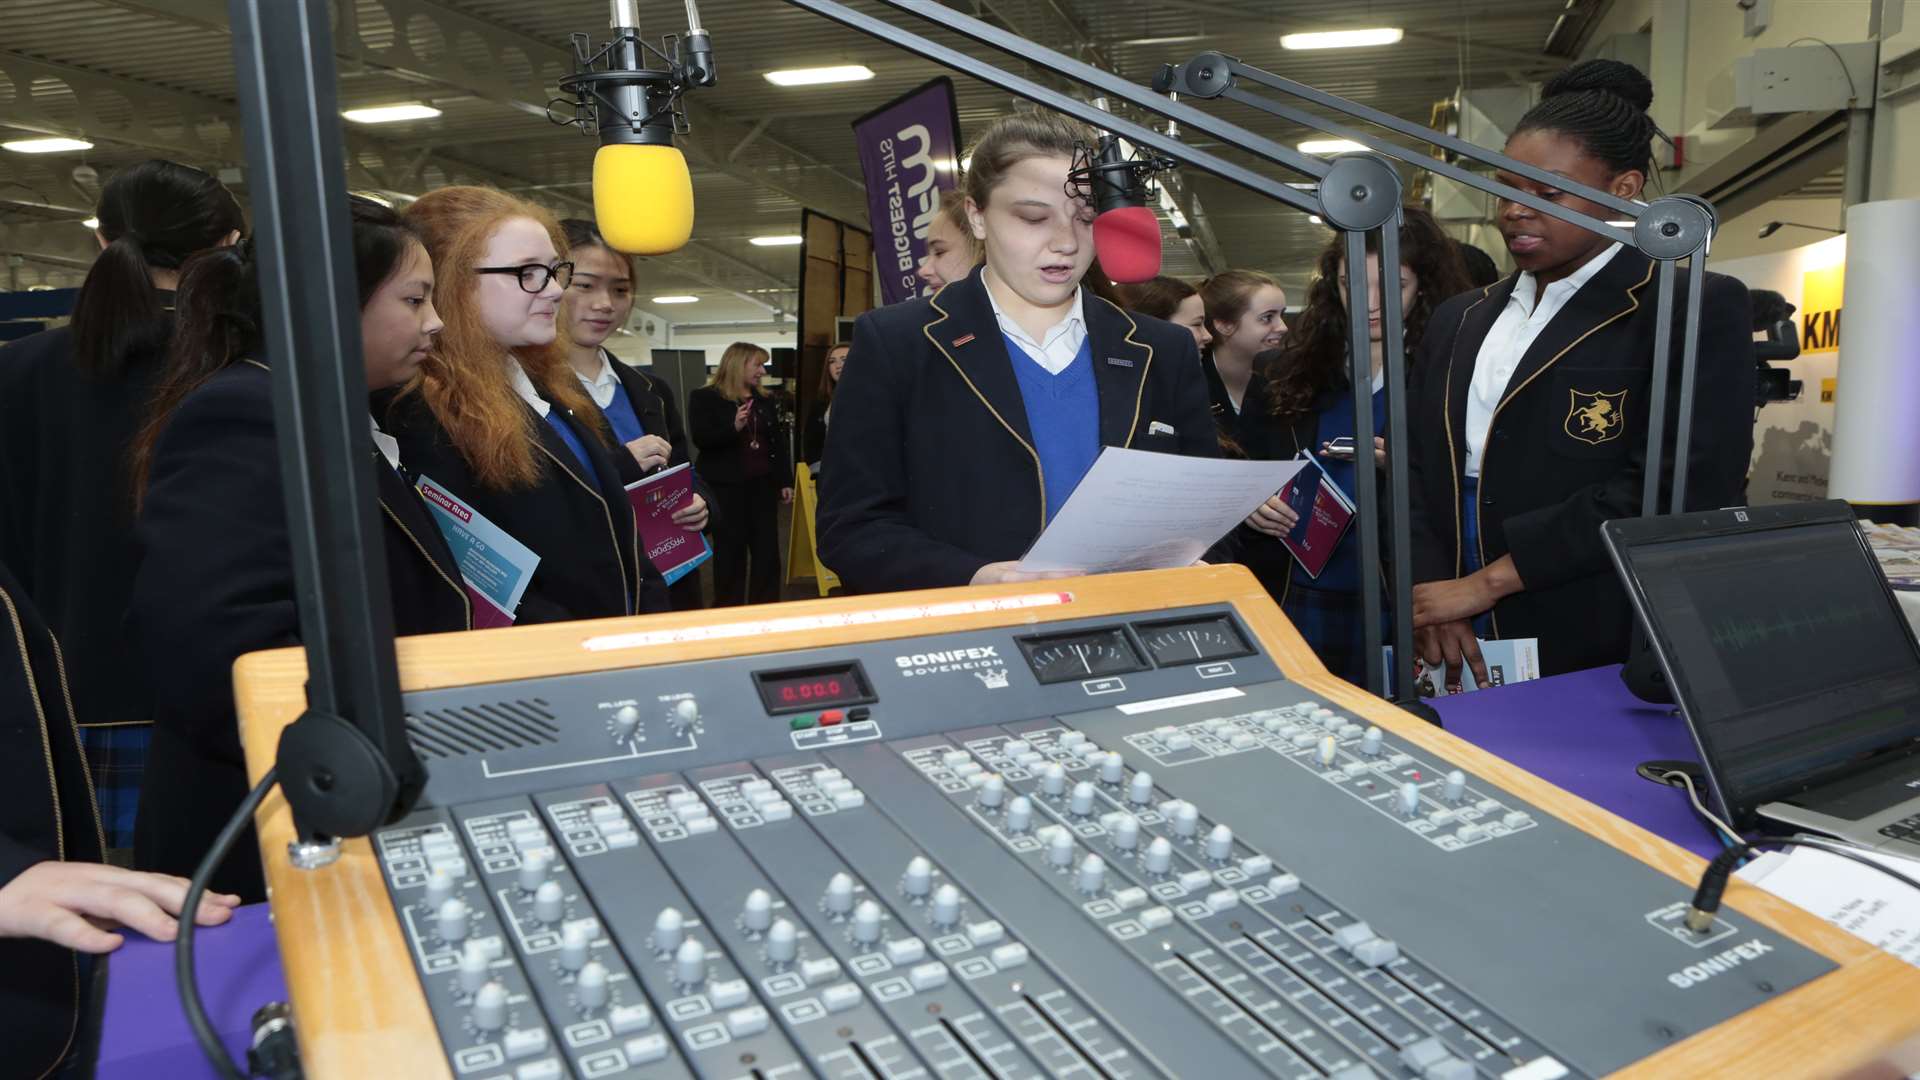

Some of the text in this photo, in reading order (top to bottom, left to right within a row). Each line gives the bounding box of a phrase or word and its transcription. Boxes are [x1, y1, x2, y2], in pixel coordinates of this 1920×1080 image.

[1804, 309, 1841, 350] KM
[422, 485, 470, 520] Seminar Area
[452, 523, 471, 541] HAVE
[475, 541, 486, 552] GO
[647, 535, 686, 559] PASSPORT
[895, 645, 999, 669] SONIFEX
[902, 658, 1004, 677] SOVEREIGN
[1666, 939, 1775, 989] SONIFEX
